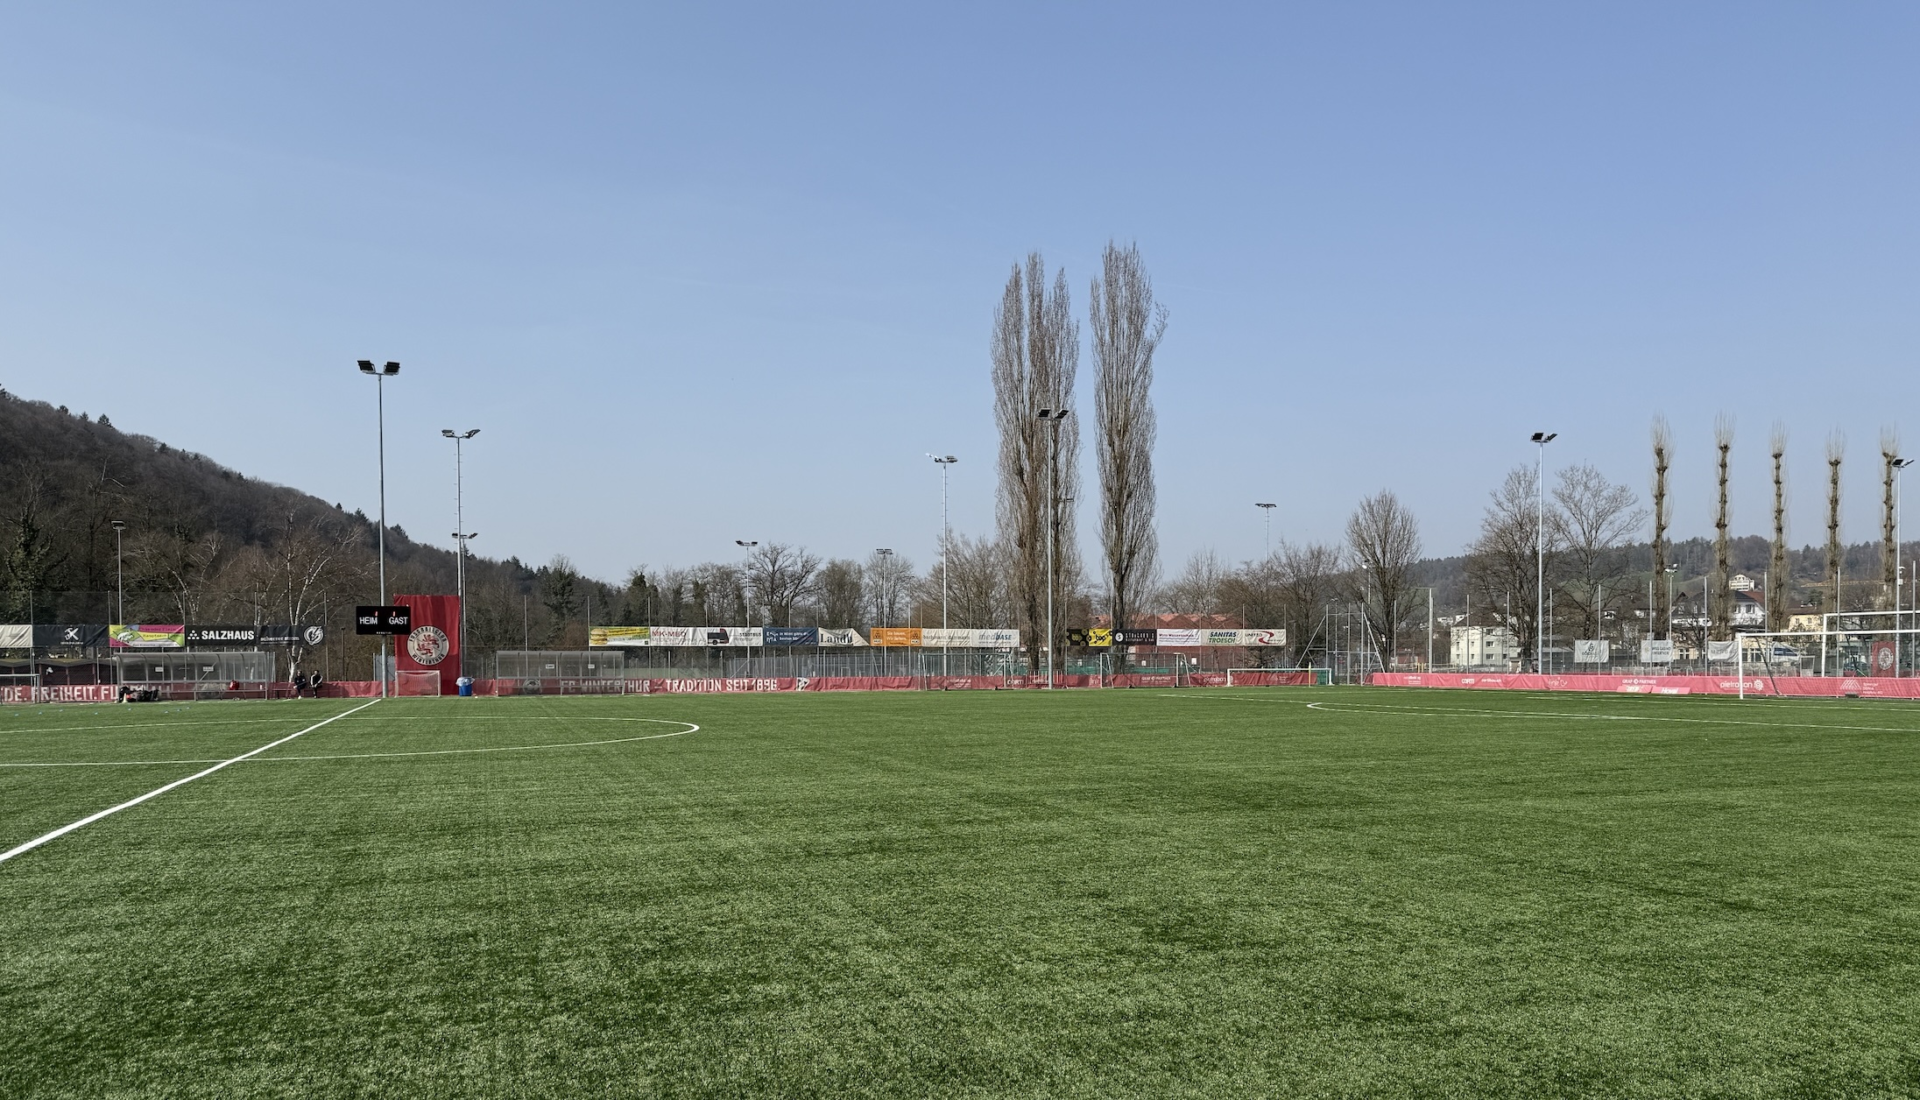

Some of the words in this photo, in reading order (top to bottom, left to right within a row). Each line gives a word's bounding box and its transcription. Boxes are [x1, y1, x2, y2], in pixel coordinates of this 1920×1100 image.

[359, 616, 378, 625] HEIM
[388, 616, 409, 625] GAST
[201, 630, 255, 640] SALZHAUS
[580, 679, 651, 693] WINTERTHUR
[666, 680, 722, 692] TRADITION
[726, 680, 750, 691] SEIT
[752, 679, 781, 691] 1896.
